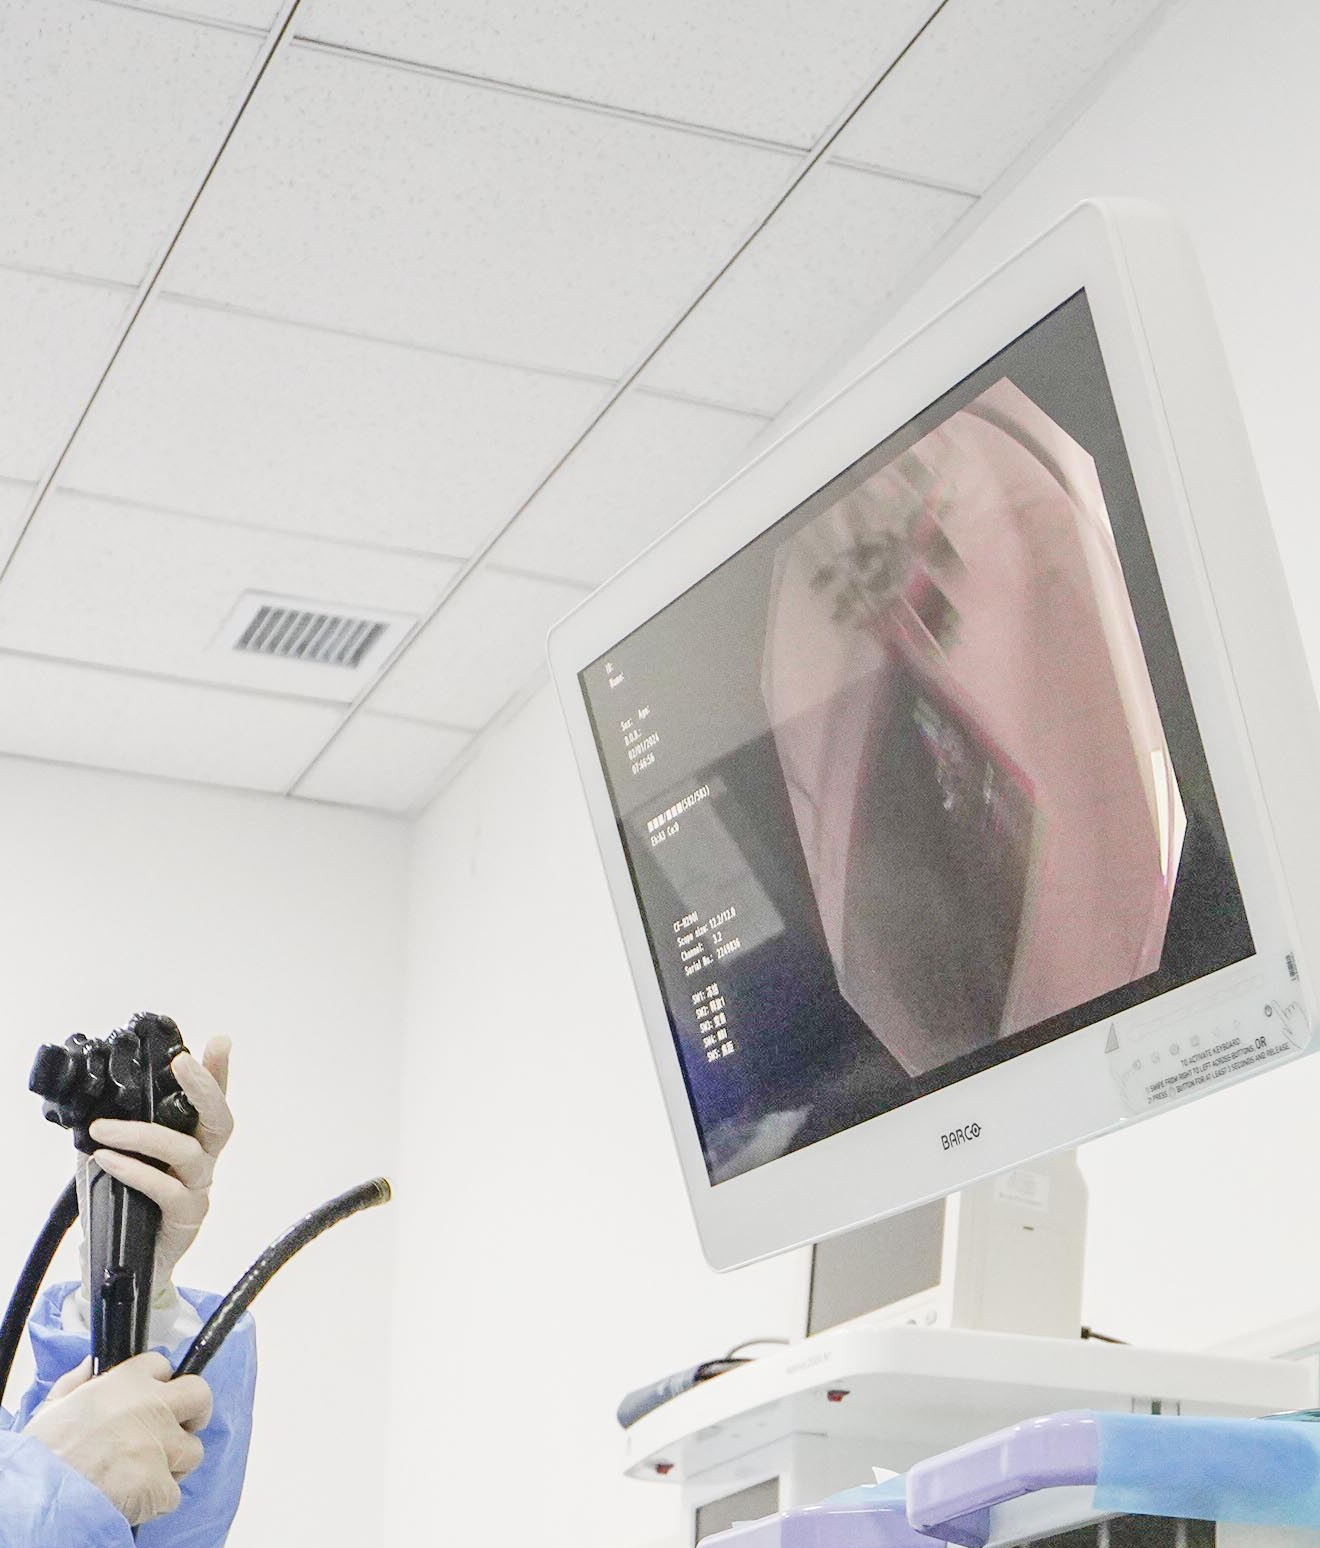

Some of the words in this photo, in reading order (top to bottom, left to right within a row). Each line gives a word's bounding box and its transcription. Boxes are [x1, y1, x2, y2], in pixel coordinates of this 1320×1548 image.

[677, 932, 694, 947] Scope
[1254, 1036, 1267, 1050] OR
[941, 1122, 982, 1151] BARCO
